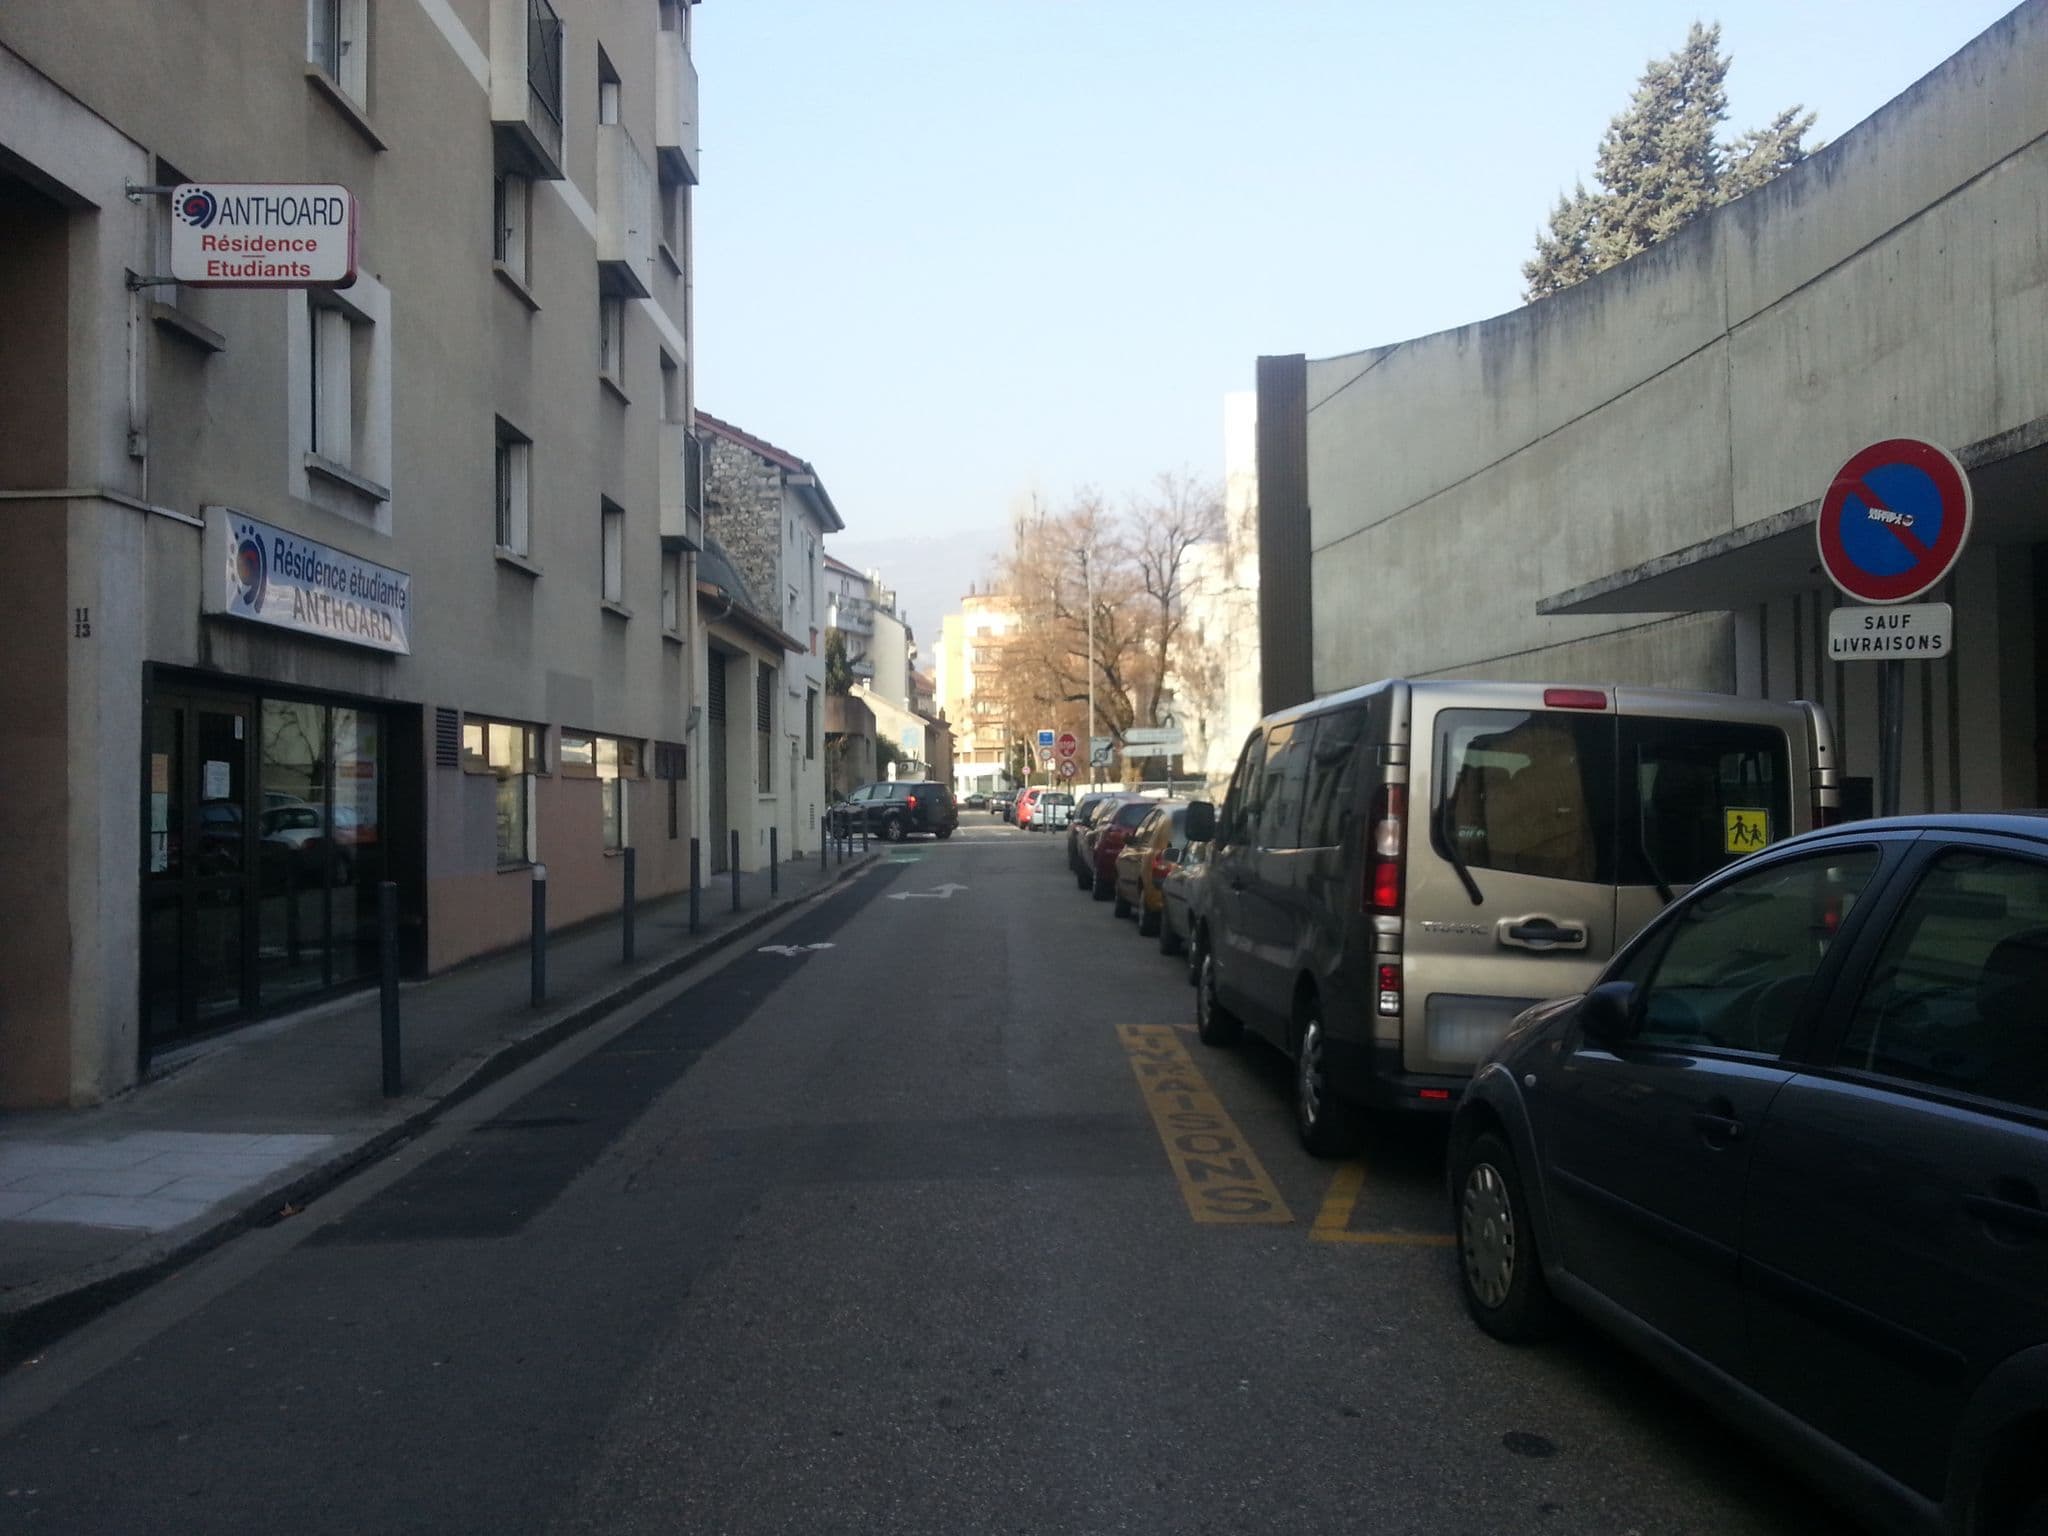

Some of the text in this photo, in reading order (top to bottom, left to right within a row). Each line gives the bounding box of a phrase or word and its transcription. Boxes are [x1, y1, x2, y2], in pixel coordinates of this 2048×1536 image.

[218, 197, 344, 226] ANTHOARD
[202, 234, 317, 252] Résidence
[207, 260, 311, 277] Etudiants
[273, 537, 406, 610] Résidence étudiante
[293, 587, 393, 642] ANTHOARD
[1864, 614, 1911, 630] SAUF
[1833, 635, 1942, 652] LIVRAISONS
